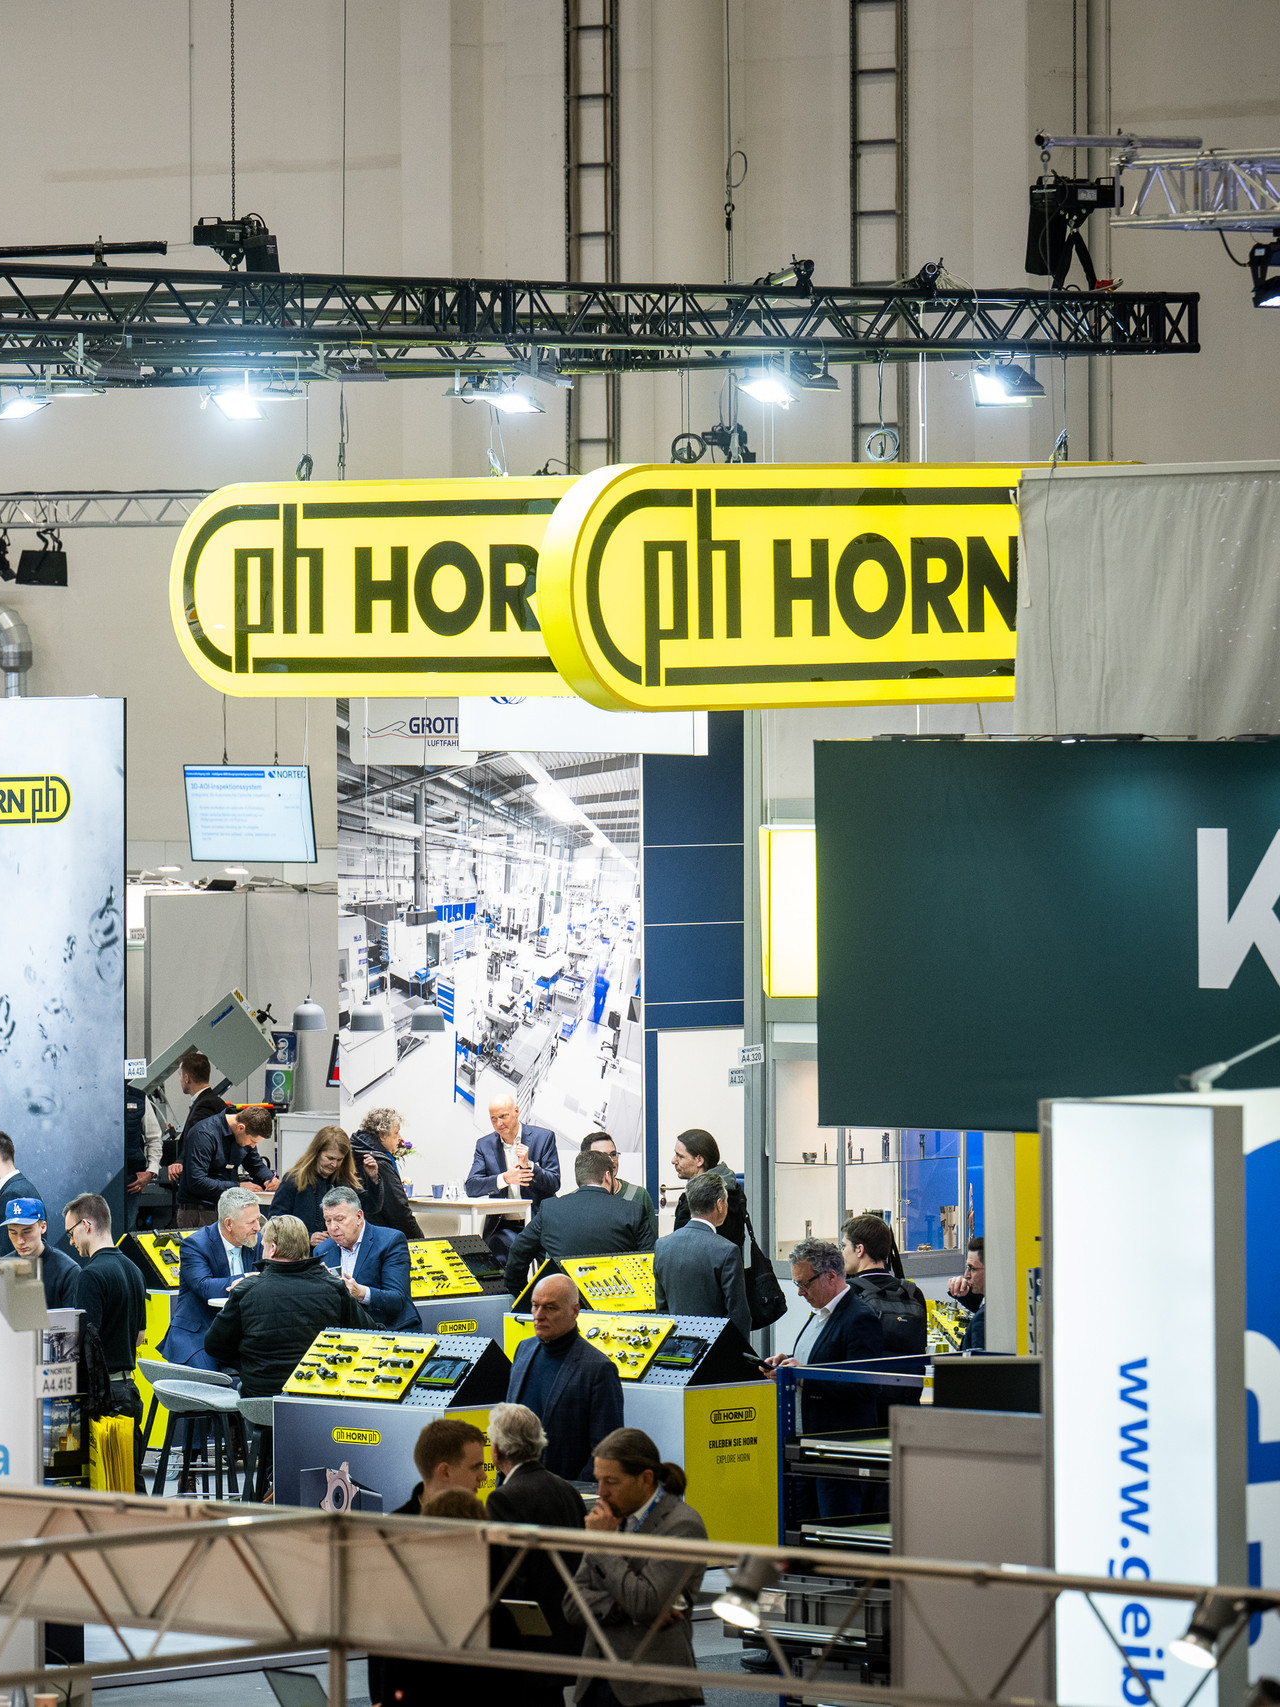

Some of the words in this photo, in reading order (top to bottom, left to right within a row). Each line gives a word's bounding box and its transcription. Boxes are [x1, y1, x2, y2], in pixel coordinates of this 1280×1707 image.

[276, 770, 307, 779] NORTEC
[741, 1052, 762, 1063] A4.320
[448, 1322, 467, 1331] HORN
[50, 1366, 72, 1376] NORTEC
[42, 1377, 73, 1393] A4.415
[723, 1411, 744, 1421] HORN
[346, 1431, 367, 1442] HORN
[708, 1439, 732, 1449] ERLEBEN
[733, 1438, 742, 1447] SIE
[742, 1436, 758, 1446] HORN
[716, 1454, 736, 1465] EXPLORE
[737, 1453, 751, 1463] HORN
